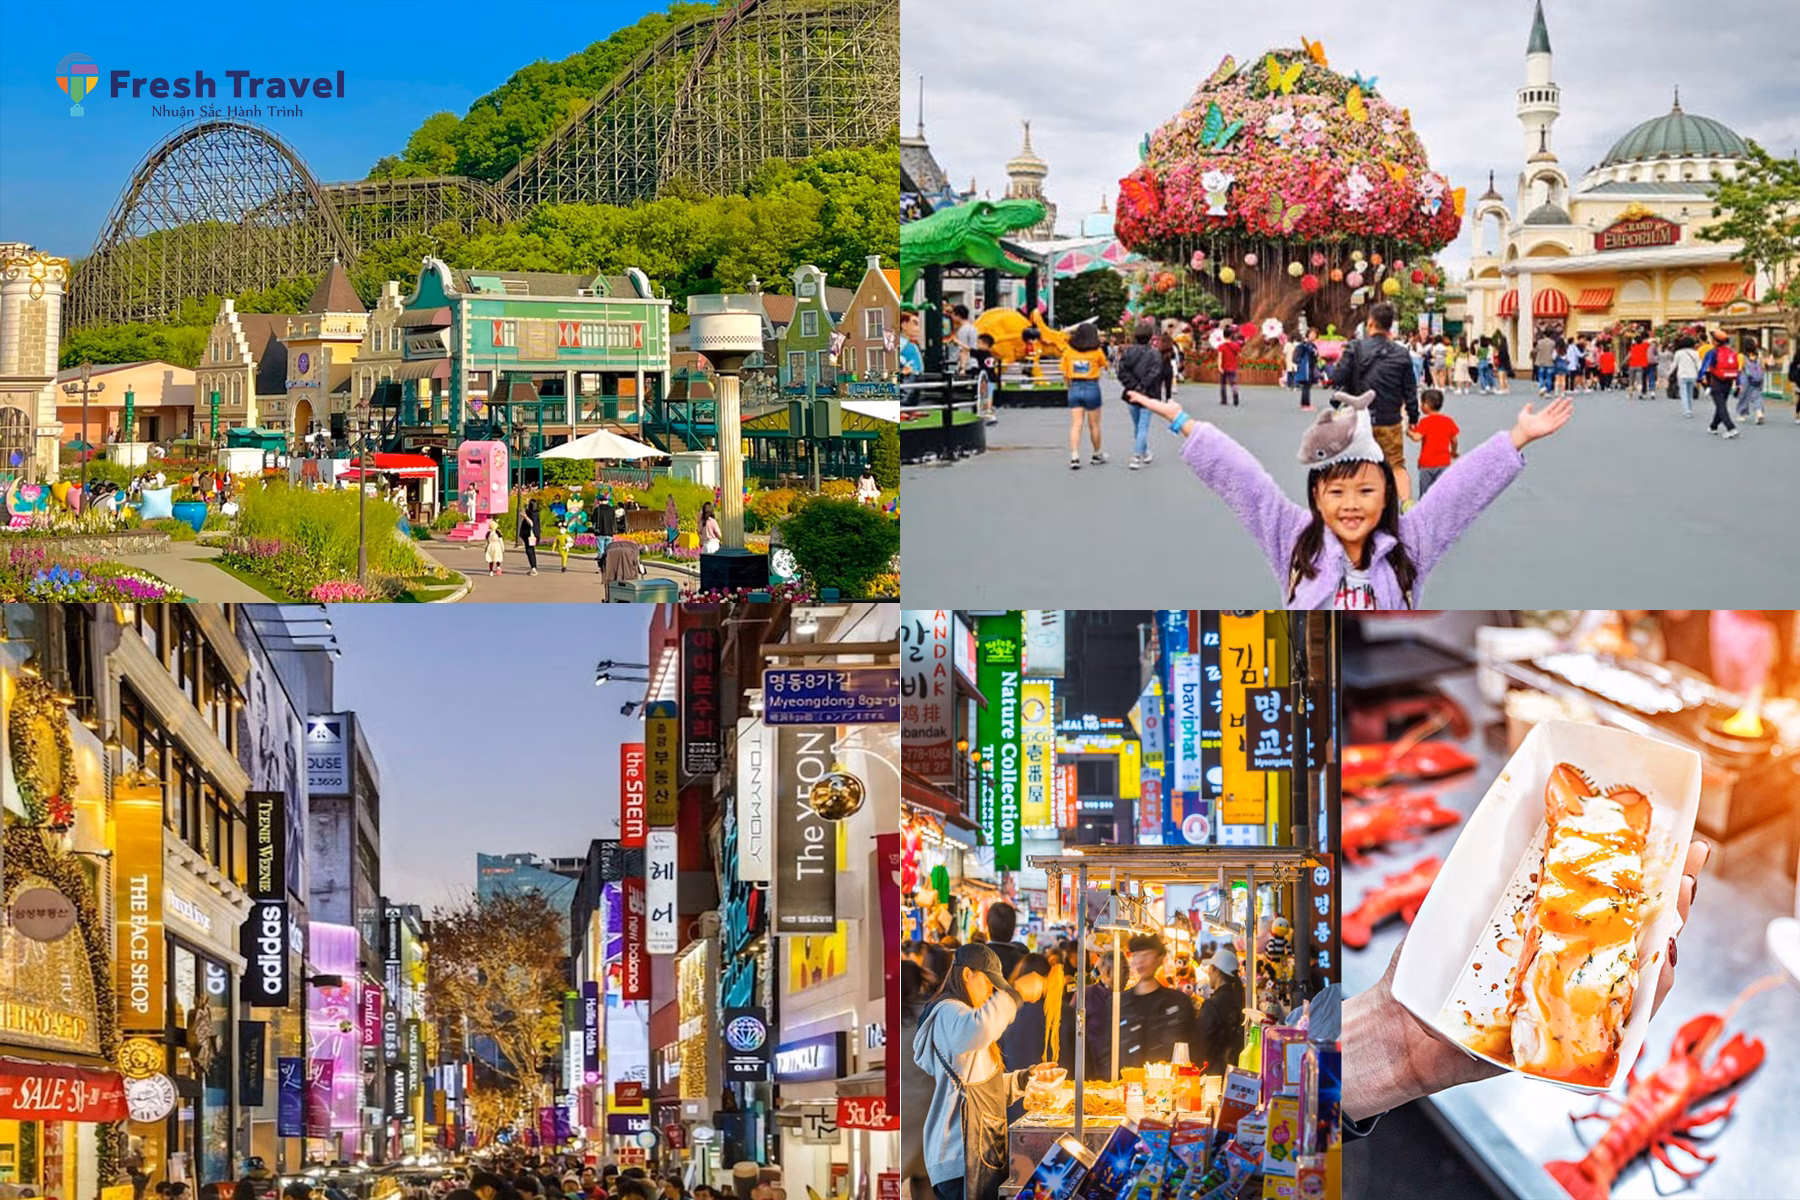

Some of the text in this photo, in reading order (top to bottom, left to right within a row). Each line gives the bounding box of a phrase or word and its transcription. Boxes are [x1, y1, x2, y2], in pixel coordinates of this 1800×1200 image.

[1604, 226, 1671, 248] EMPORIUM
[1623, 221, 1653, 232] GRAND
[769, 672, 851, 692] 명동8가길
[769, 696, 855, 709] Myeongdong
[1181, 683, 1198, 762] baviphat
[1001, 671, 1019, 846] Nature Collection
[626, 752, 643, 838] the SAEM
[750, 734, 761, 862] TONYMOLY
[259, 799, 273, 844] TEENIE
[797, 825, 824, 881] The
[650, 861, 674, 923] 헤어
[130, 875, 149, 1014] THE FACE SHOP
[257, 906, 282, 994] adidas
[628, 916, 640, 943] new
[364, 989, 380, 1027] banila
[385, 1011, 396, 1059] GUESS
[13, 1077, 67, 1110] SALE
